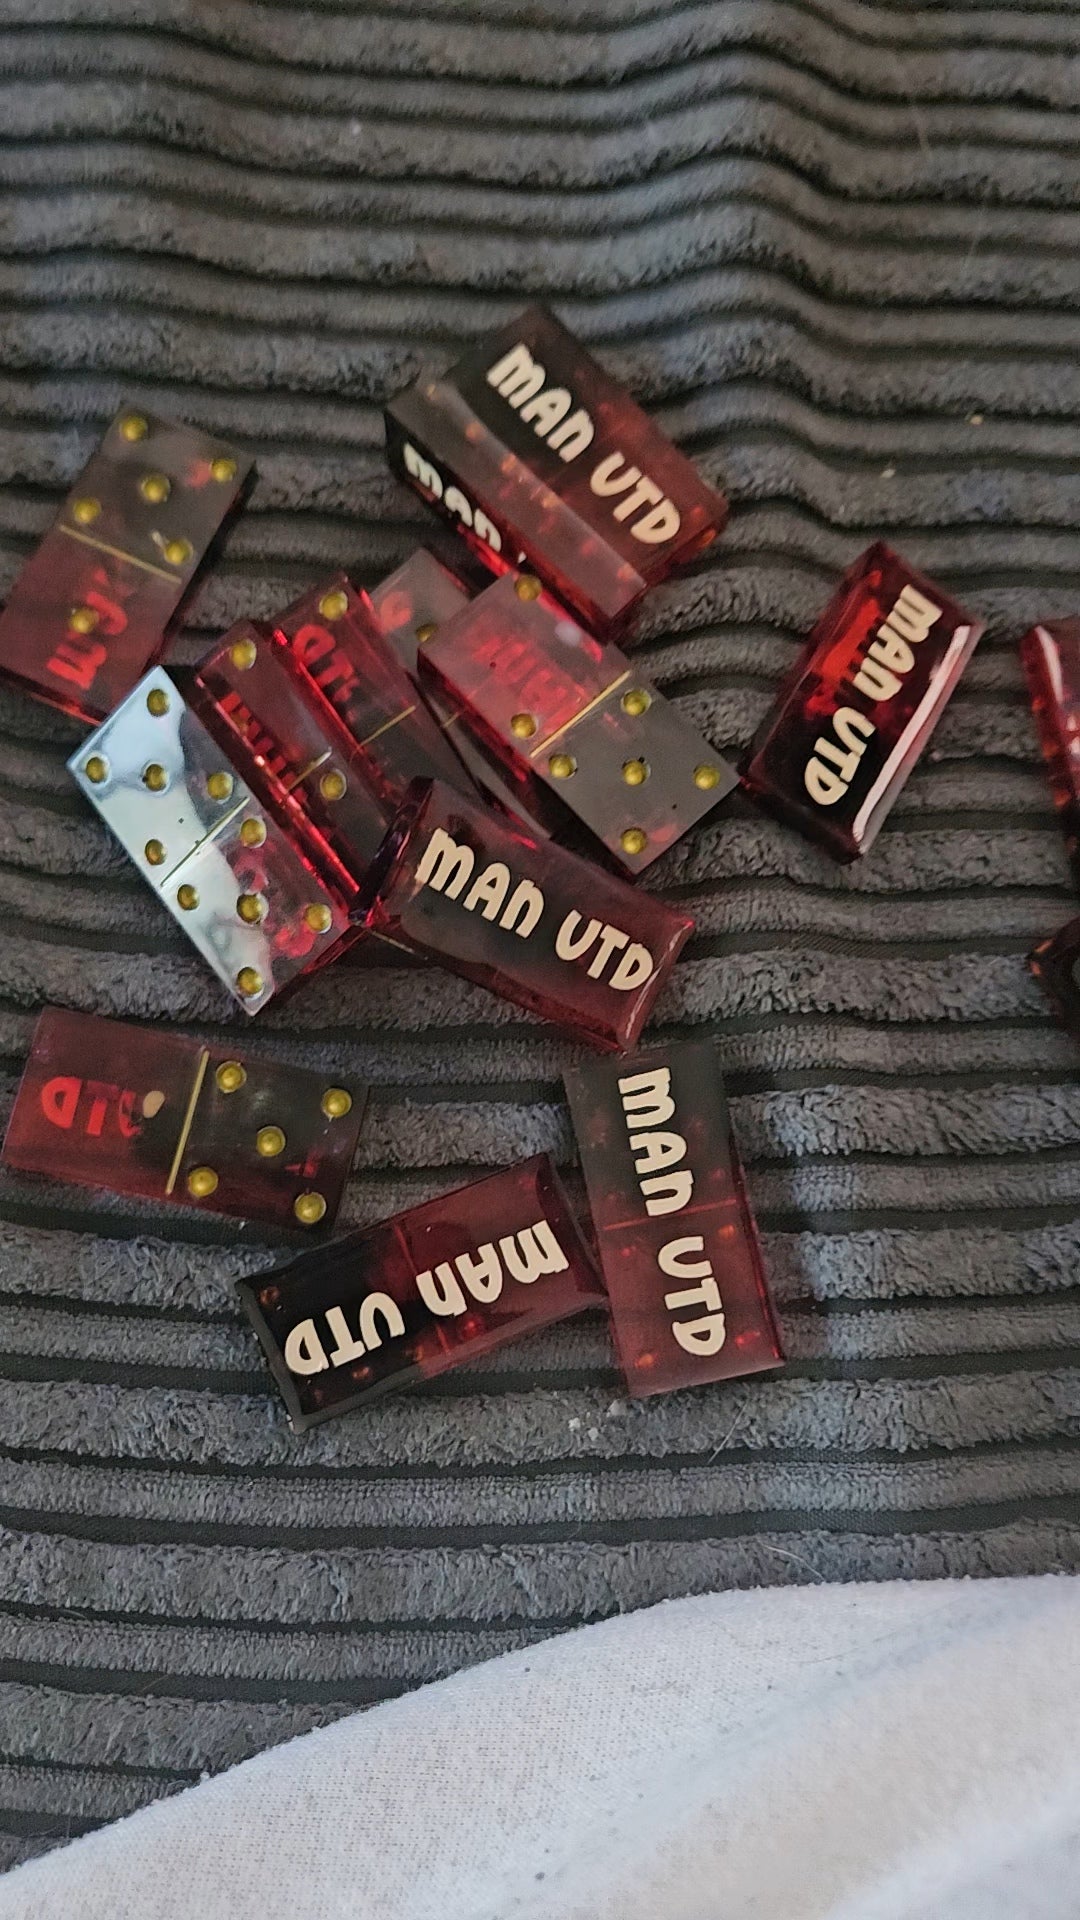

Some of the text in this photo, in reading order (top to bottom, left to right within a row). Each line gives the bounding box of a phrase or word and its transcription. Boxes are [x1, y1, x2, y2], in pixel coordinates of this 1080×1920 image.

[487, 344, 681, 544] MAN UTD
[804, 584, 943, 806] MAN UTD
[414, 827, 544, 938] MAN
[555, 909, 654, 991] UTD
[284, 1219, 570, 1376] MAN UTD
[617, 1067, 726, 1356] MAN UTD
